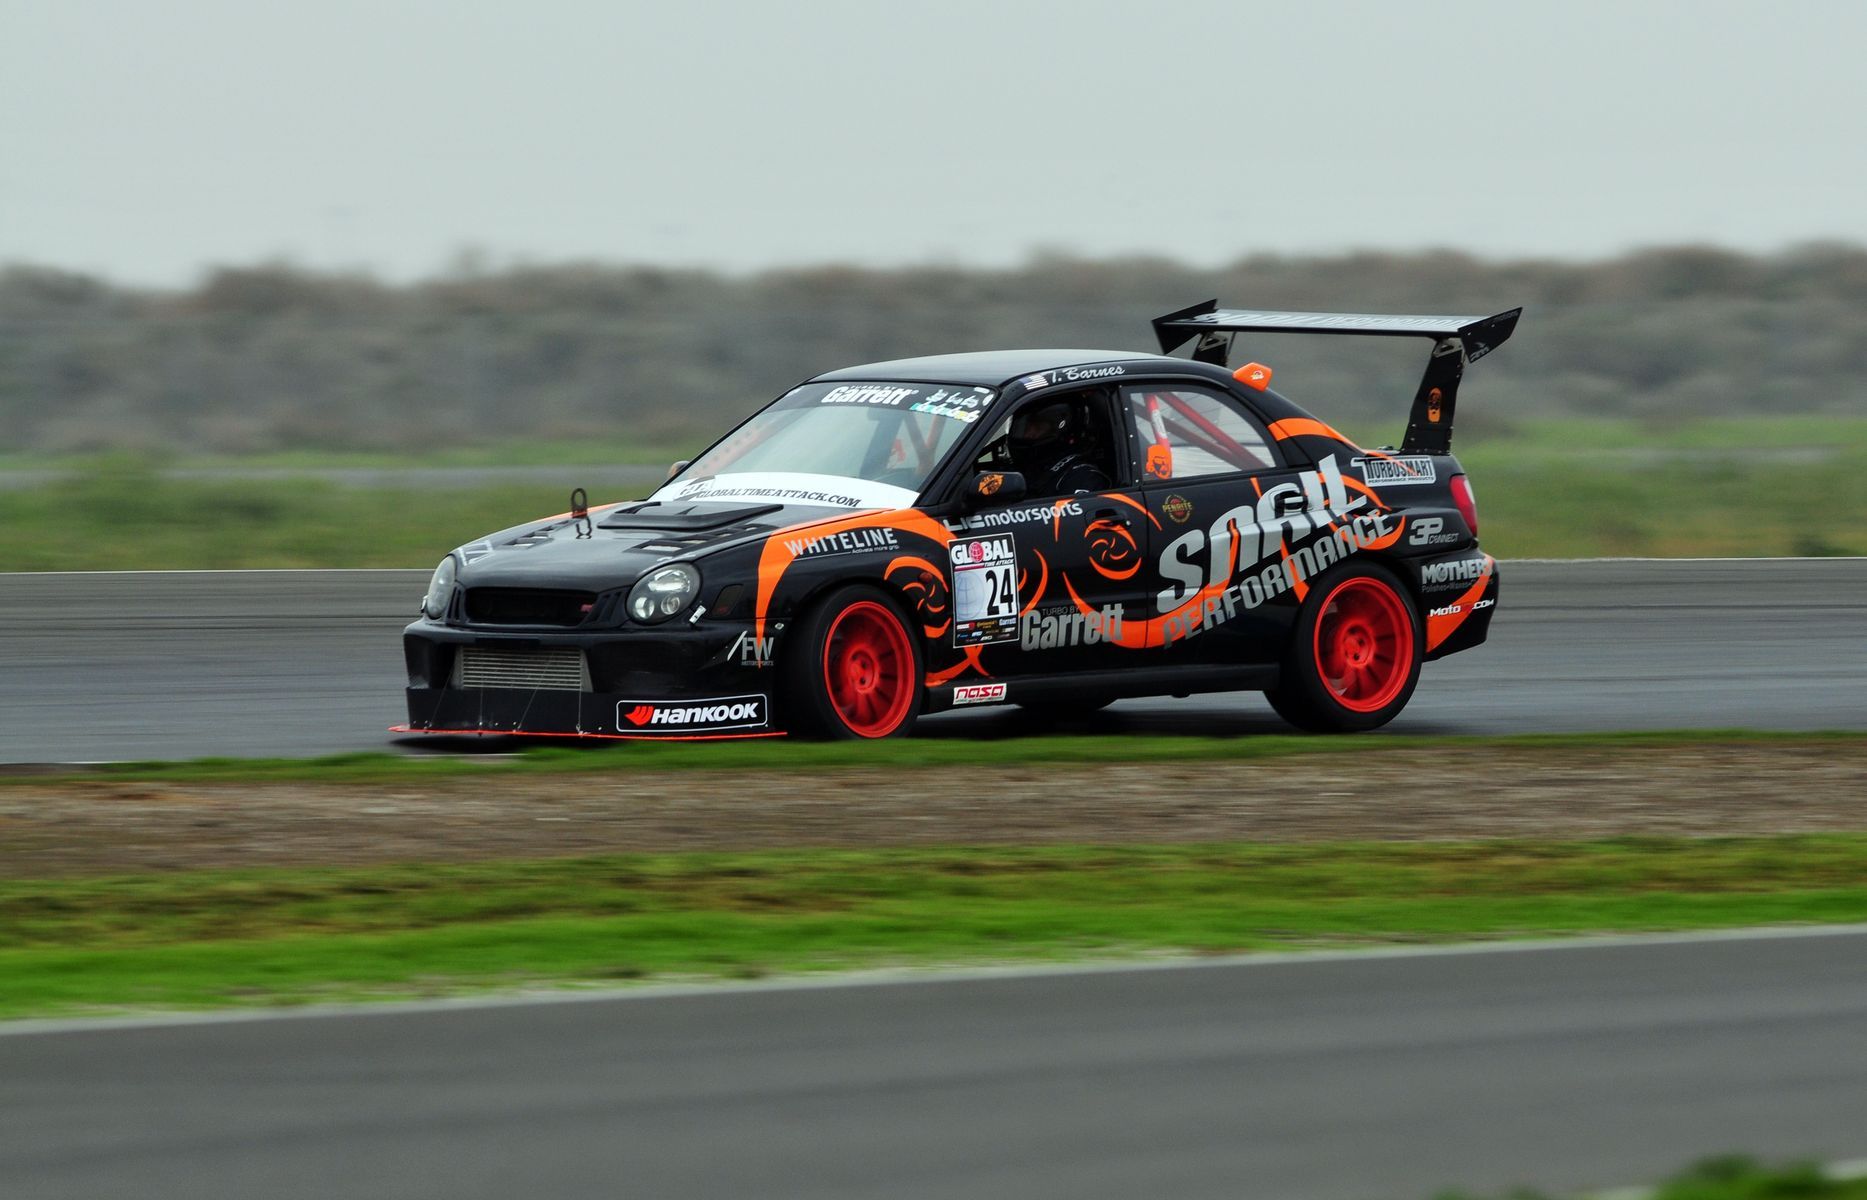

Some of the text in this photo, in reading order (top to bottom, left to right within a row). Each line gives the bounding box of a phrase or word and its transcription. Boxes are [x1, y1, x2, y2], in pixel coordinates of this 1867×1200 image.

[1062, 365, 1125, 380] Barnes
[784, 527, 898, 557] WHITELINE
[951, 539, 1013, 564] GLOBAL
[985, 568, 1014, 617] 24
[1163, 509, 1394, 650] PERFORMANCE
[1042, 607, 1068, 615] TURBO
[1021, 603, 1124, 652] Garrett
